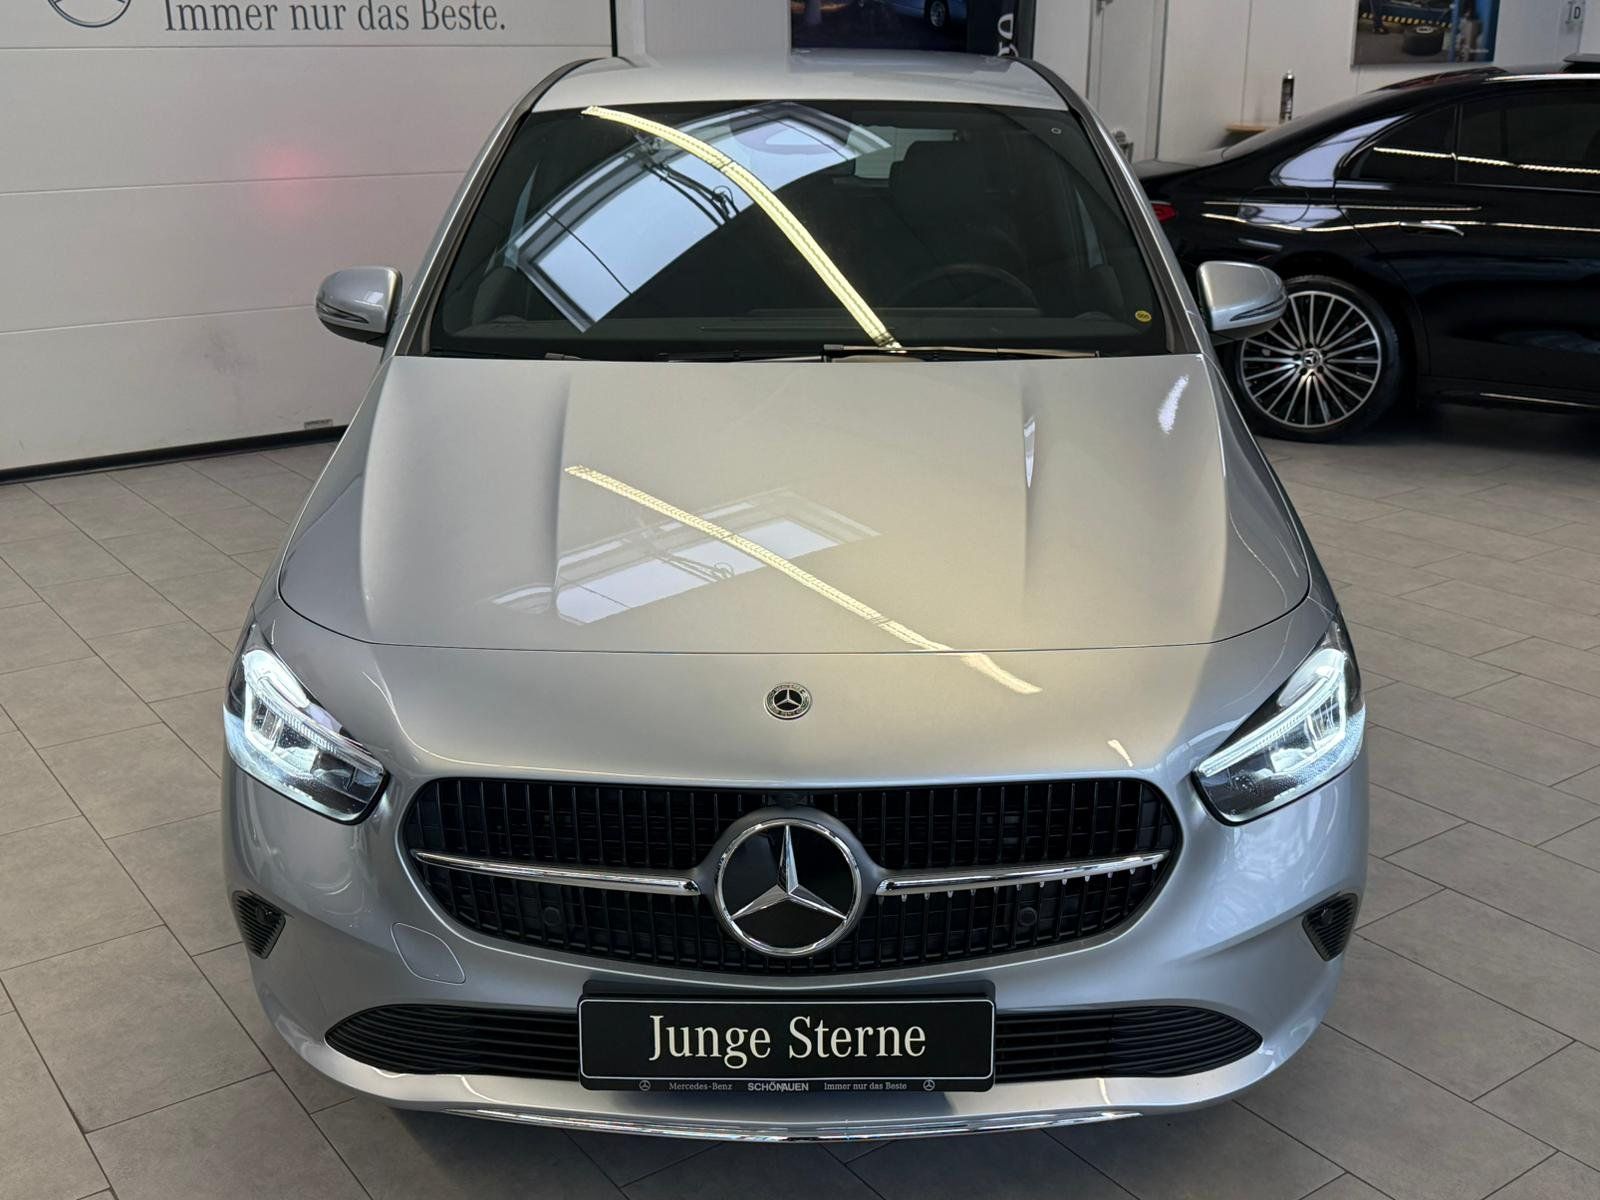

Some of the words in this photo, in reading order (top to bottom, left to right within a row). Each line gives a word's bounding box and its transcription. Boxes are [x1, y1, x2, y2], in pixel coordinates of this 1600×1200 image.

[165, 0, 278, 31] Immer
[289, 3, 347, 31] nur
[358, 0, 409, 31] das
[421, 0, 505, 31] Beste.
[648, 1015, 771, 1069] Junge
[789, 1016, 926, 1059] Sterne
[669, 1082, 733, 1091] Mercedes-Benz
[824, 1082, 850, 1091] Immer
[853, 1082, 867, 1091] nur
[869, 1081, 883, 1090] das
[885, 1081, 908, 1090] Beste
